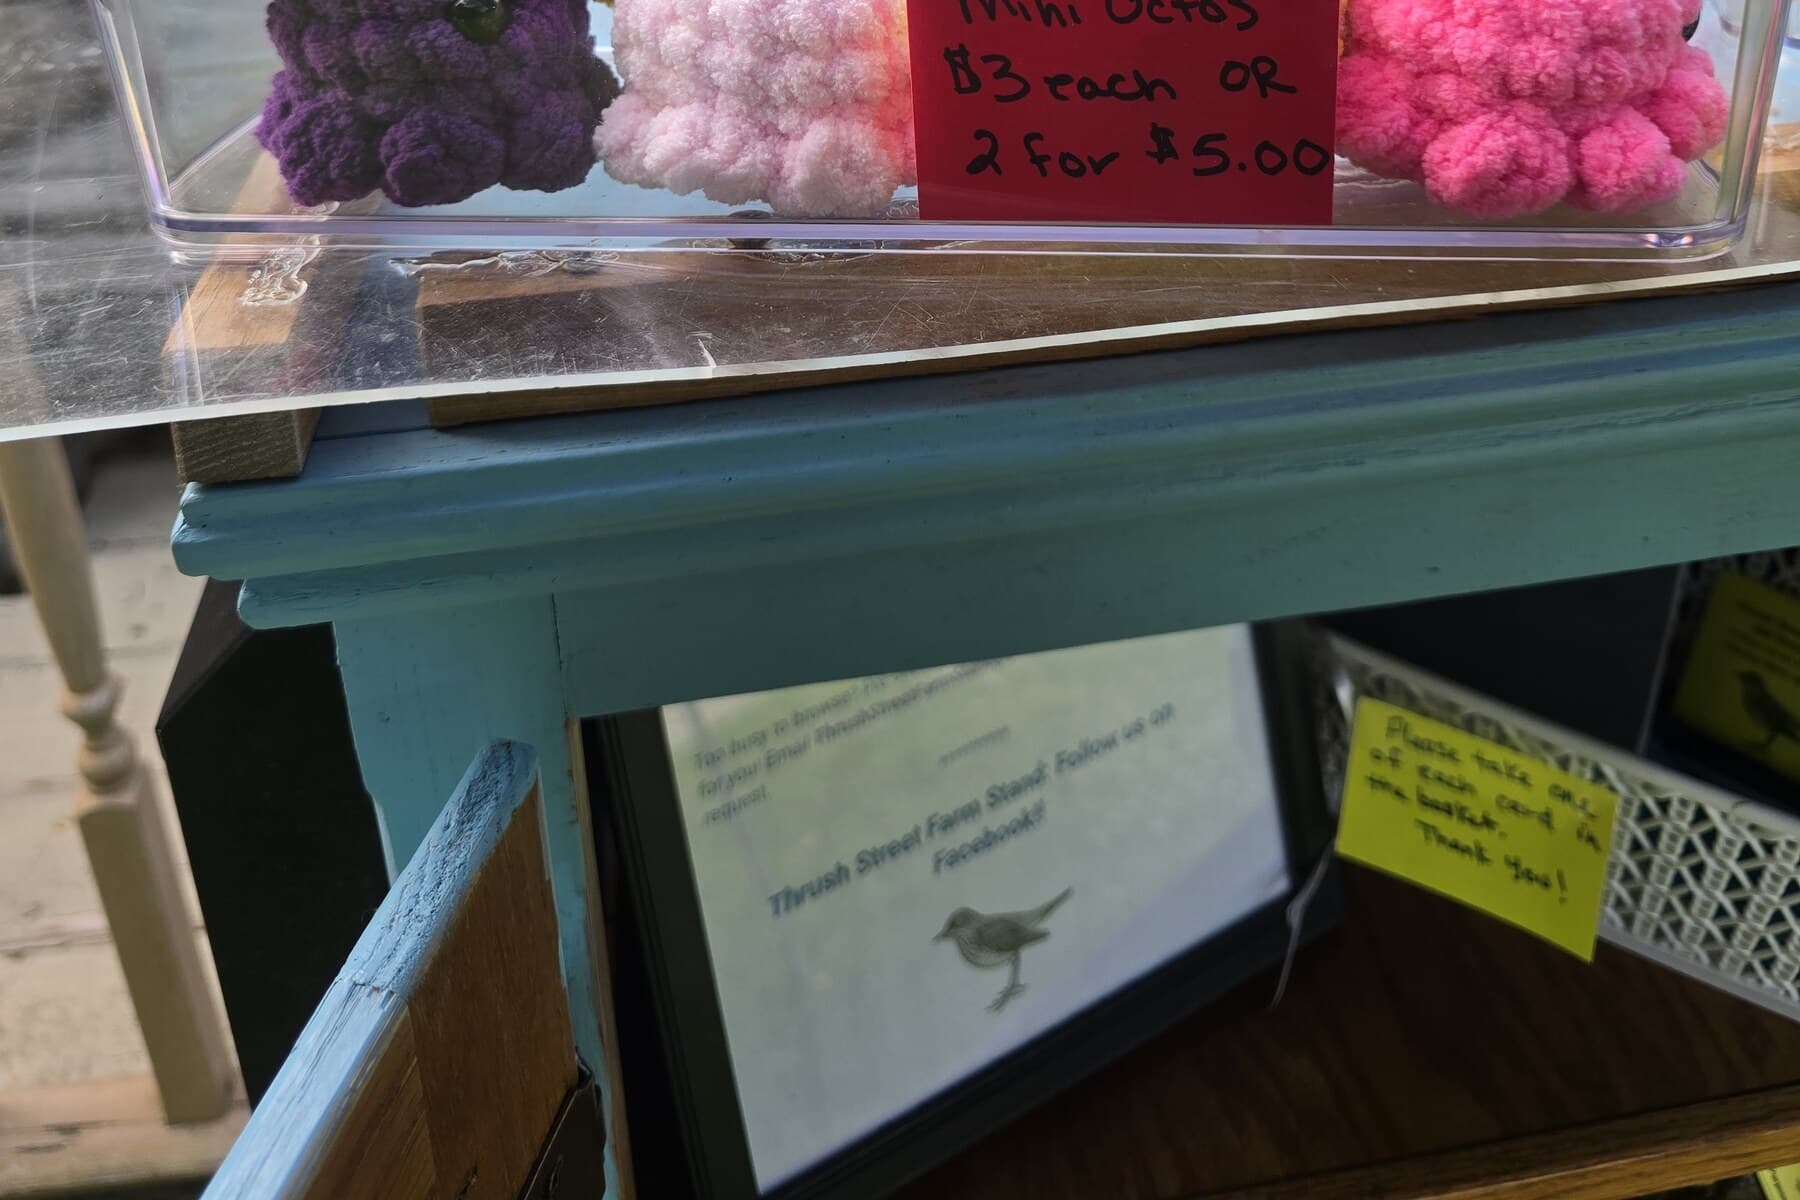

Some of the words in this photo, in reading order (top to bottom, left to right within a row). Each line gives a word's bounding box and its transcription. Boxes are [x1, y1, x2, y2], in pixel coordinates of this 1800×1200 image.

[943, 43, 1031, 103] $3
[1044, 69, 1177, 101] each
[1219, 55, 1297, 98] OR
[965, 129, 1003, 175] 2
[1023, 132, 1120, 178] for
[1145, 122, 1330, 177] $5.00
[1368, 745, 1402, 769] of
[1385, 715, 1462, 762] Please
[1471, 751, 1534, 790] take
[769, 861, 850, 918] Thrush
[855, 823, 922, 874] Street
[925, 799, 981, 838] Farm
[1054, 730, 1119, 774] Follow
[1121, 717, 1146, 740] us
[1149, 702, 1174, 726] on
[1414, 817, 1493, 866] Thank
